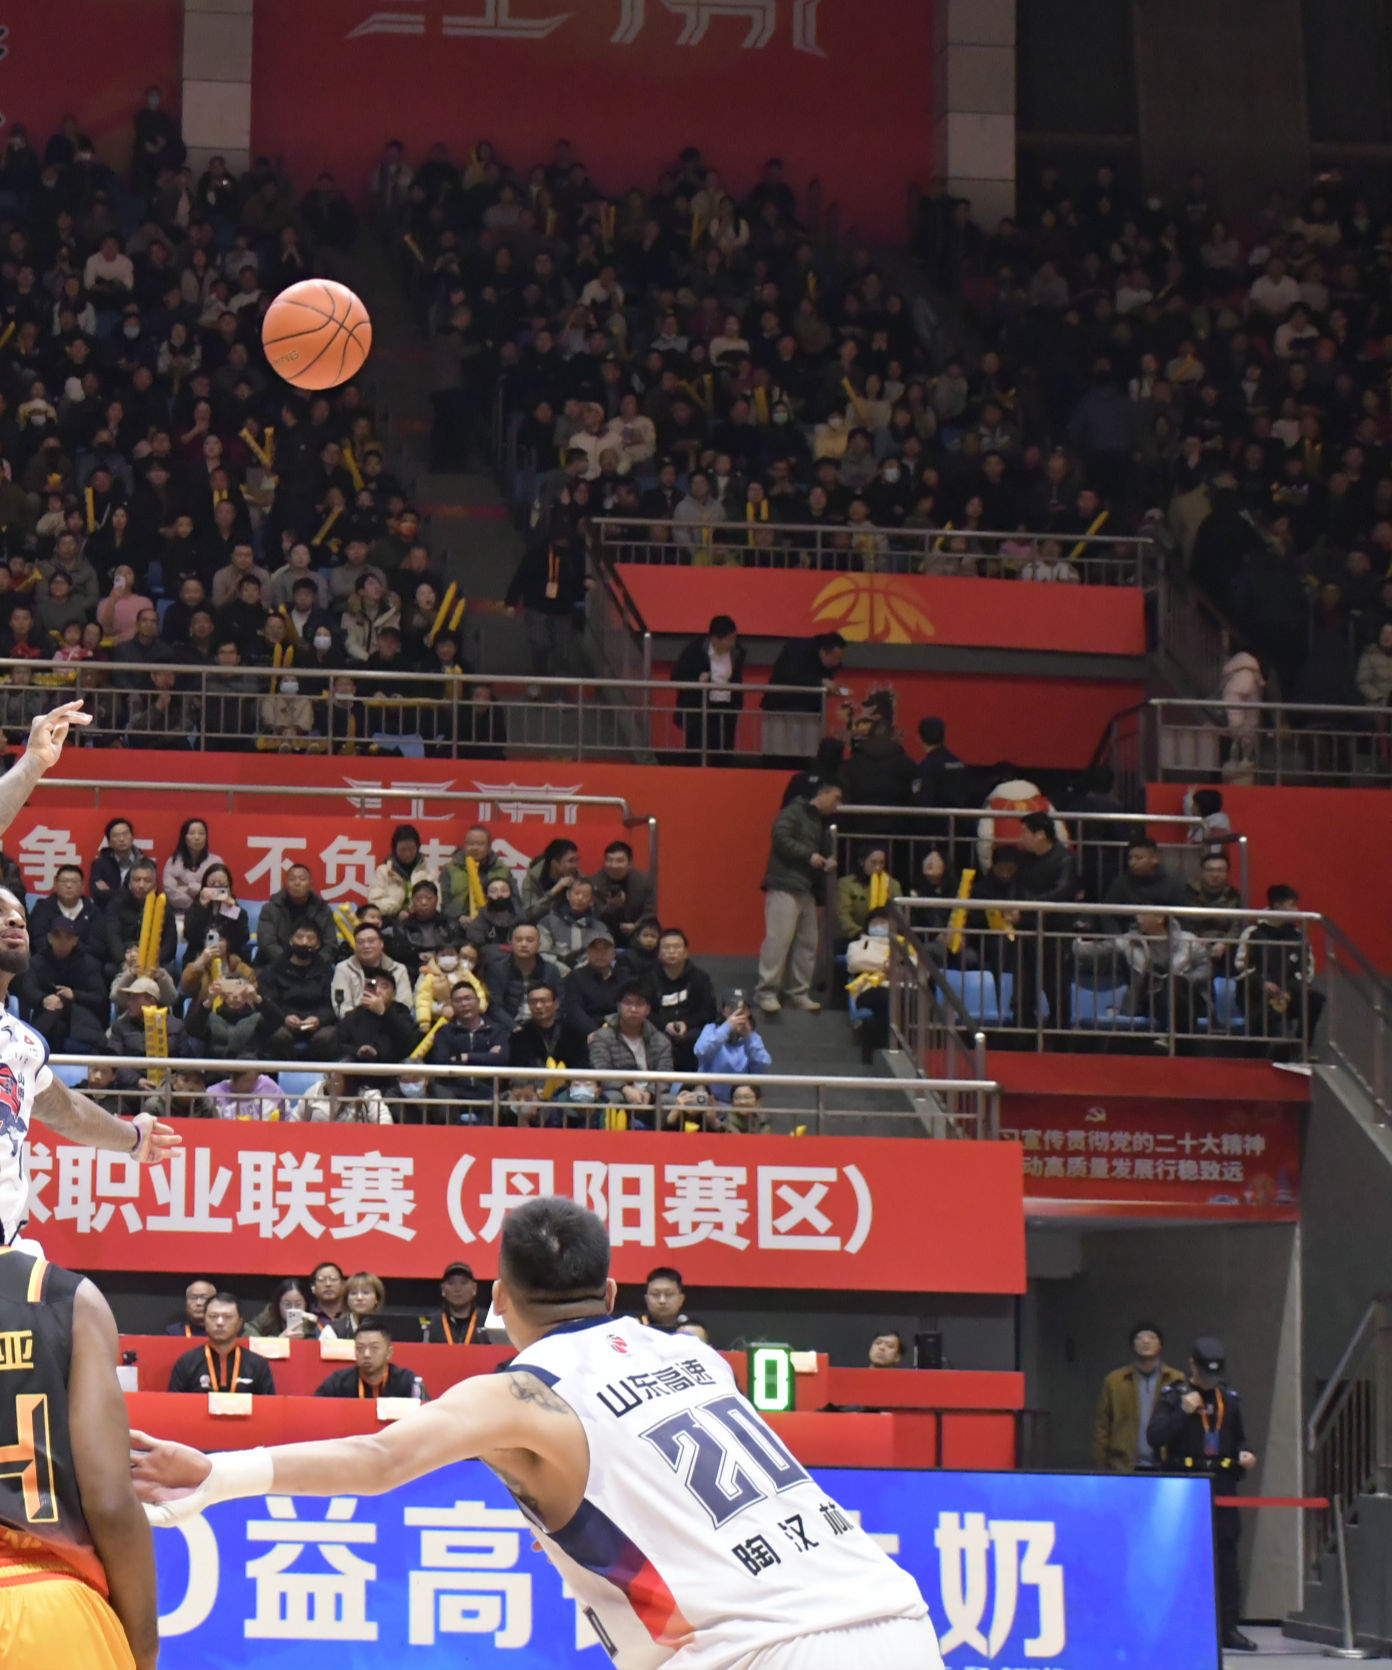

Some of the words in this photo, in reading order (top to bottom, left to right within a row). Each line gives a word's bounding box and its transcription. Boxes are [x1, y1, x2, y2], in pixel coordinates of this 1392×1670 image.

[596, 1358, 716, 1418] 山东高速
[753, 1348, 791, 1411] 0
[638, 1393, 816, 1529] 20
